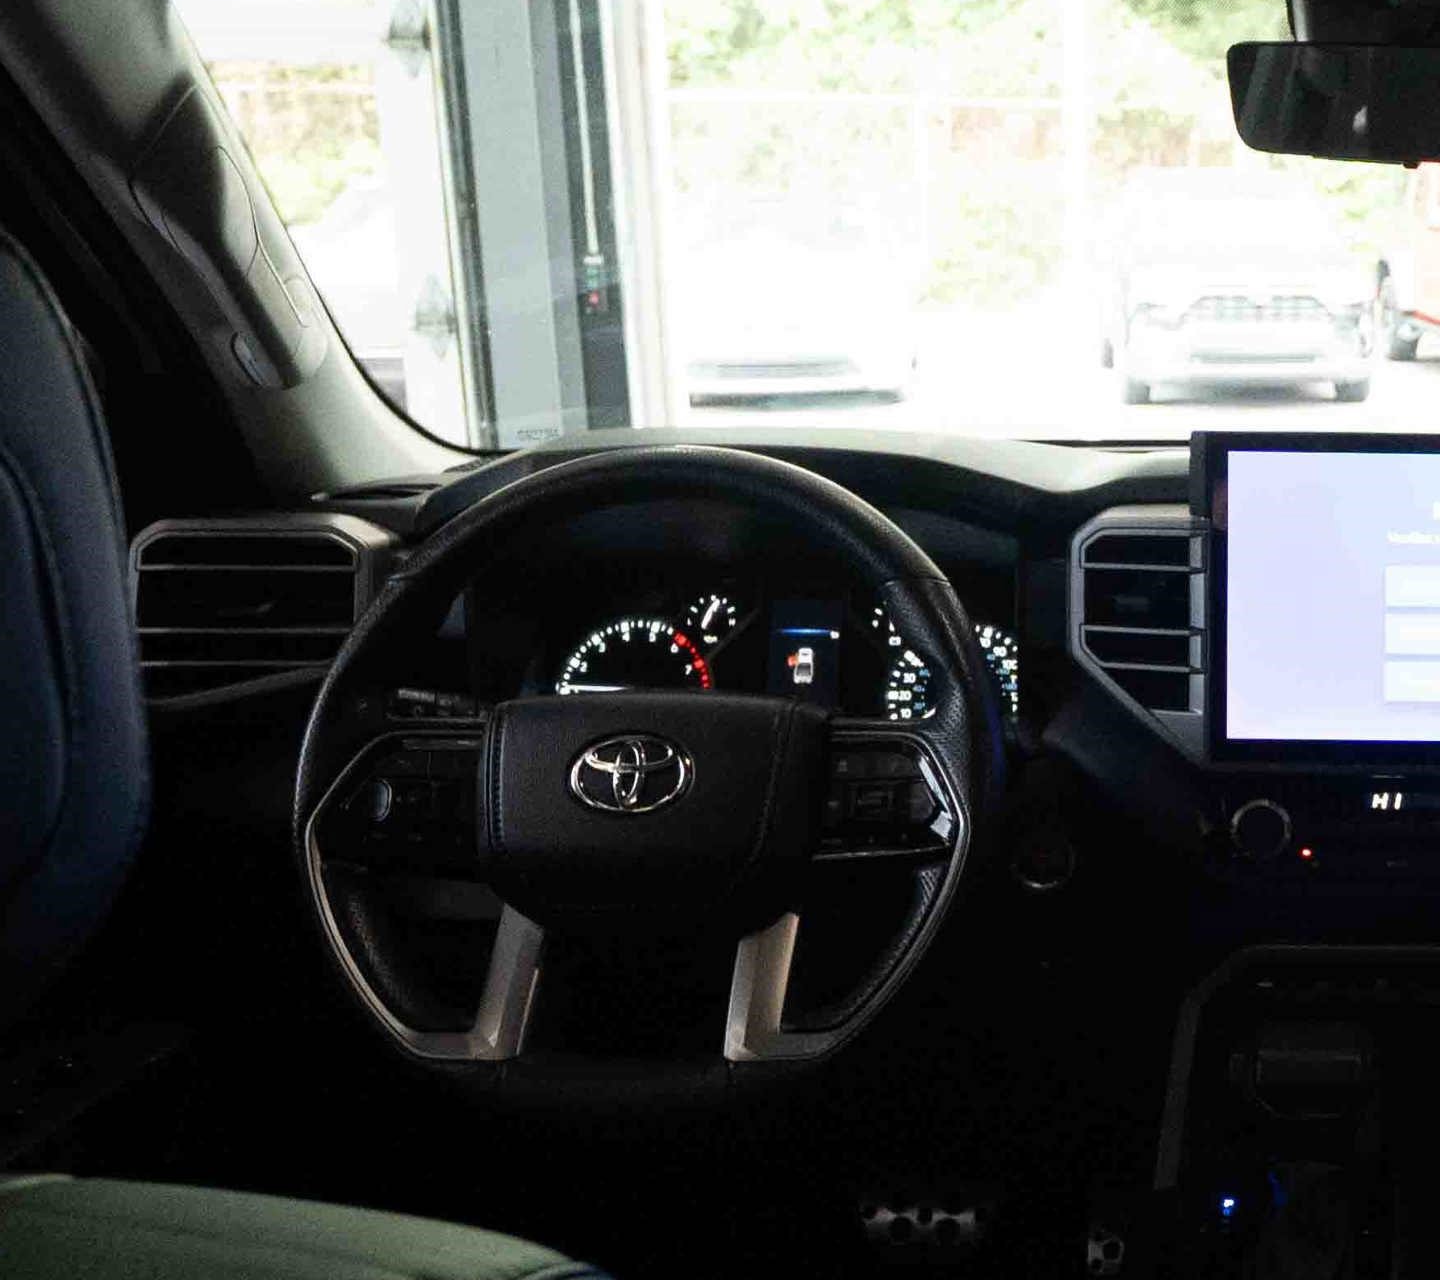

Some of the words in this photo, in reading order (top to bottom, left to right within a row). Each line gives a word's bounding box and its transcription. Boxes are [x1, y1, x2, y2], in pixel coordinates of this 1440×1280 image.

[580, 661, 588, 672] 2
[685, 664, 693, 675] 7
[900, 708, 912, 718] 10
